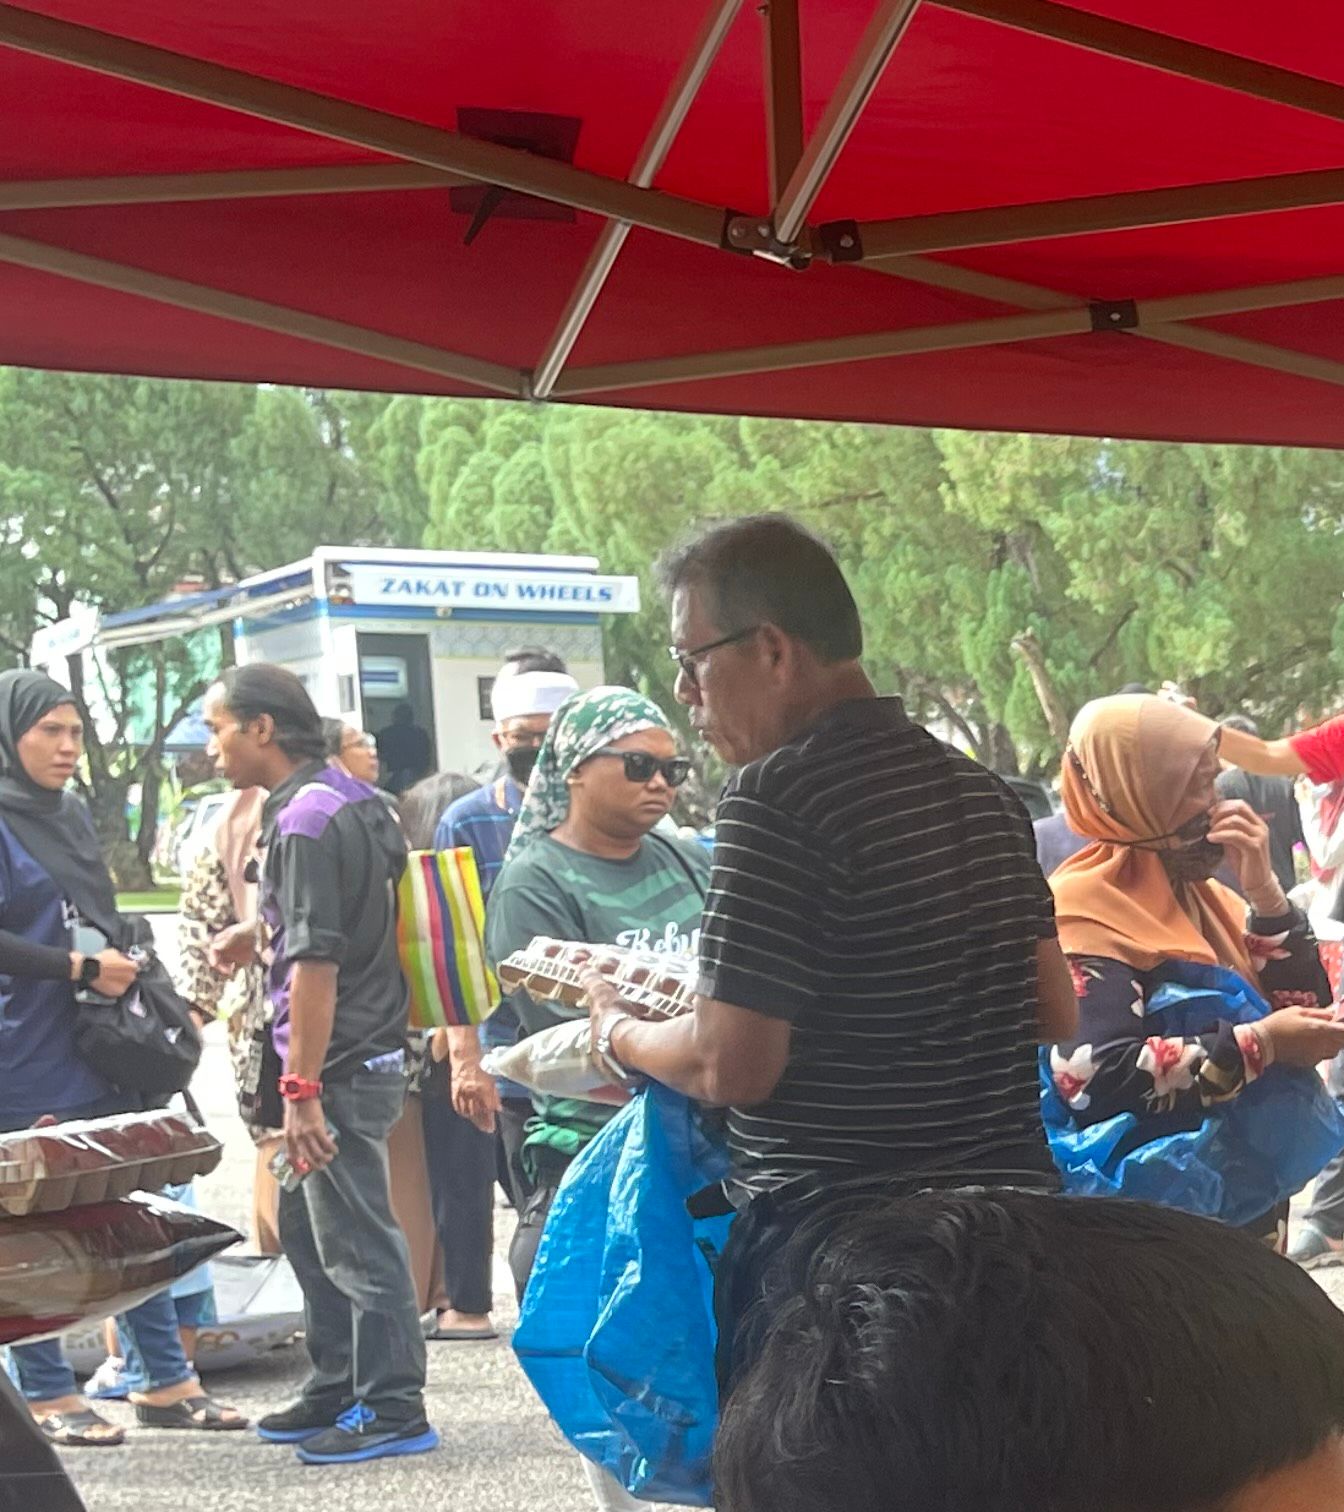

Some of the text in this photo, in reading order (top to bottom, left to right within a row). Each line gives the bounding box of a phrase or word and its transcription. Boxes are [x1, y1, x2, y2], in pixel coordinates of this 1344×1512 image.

[381, 576, 613, 602] ZAKAT ON WHEELS
